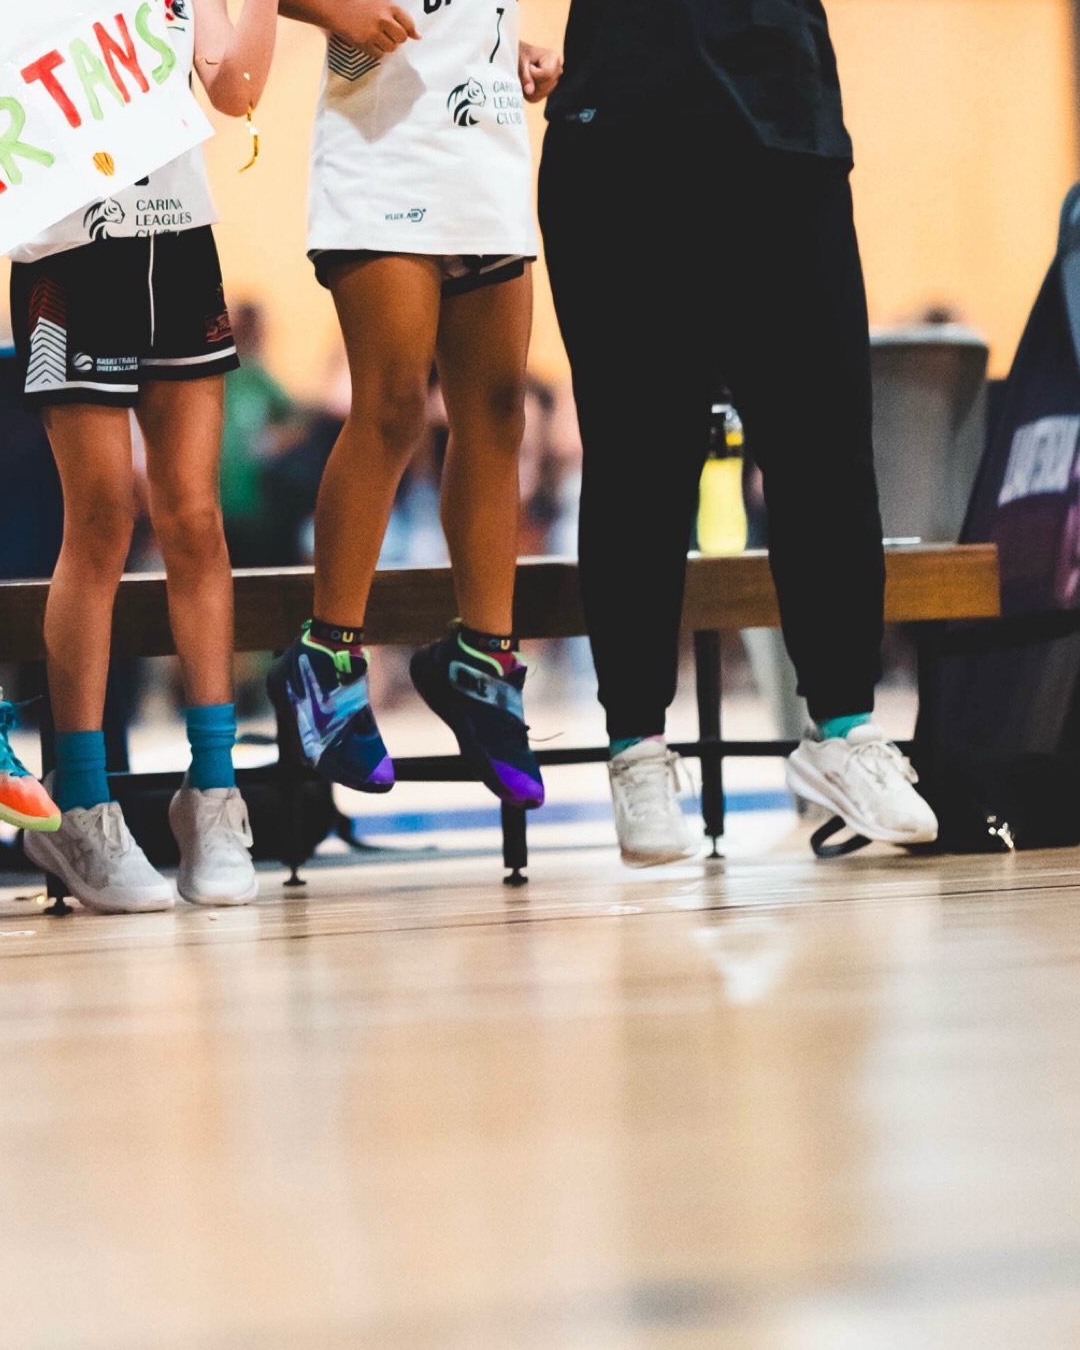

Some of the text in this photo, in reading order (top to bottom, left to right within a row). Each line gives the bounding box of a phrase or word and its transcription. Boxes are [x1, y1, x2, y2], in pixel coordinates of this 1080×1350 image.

[489, 7, 504, 63] 7
[135, 212, 193, 227] LEAGUES
[96, 356, 138, 365] BASKETBALL
